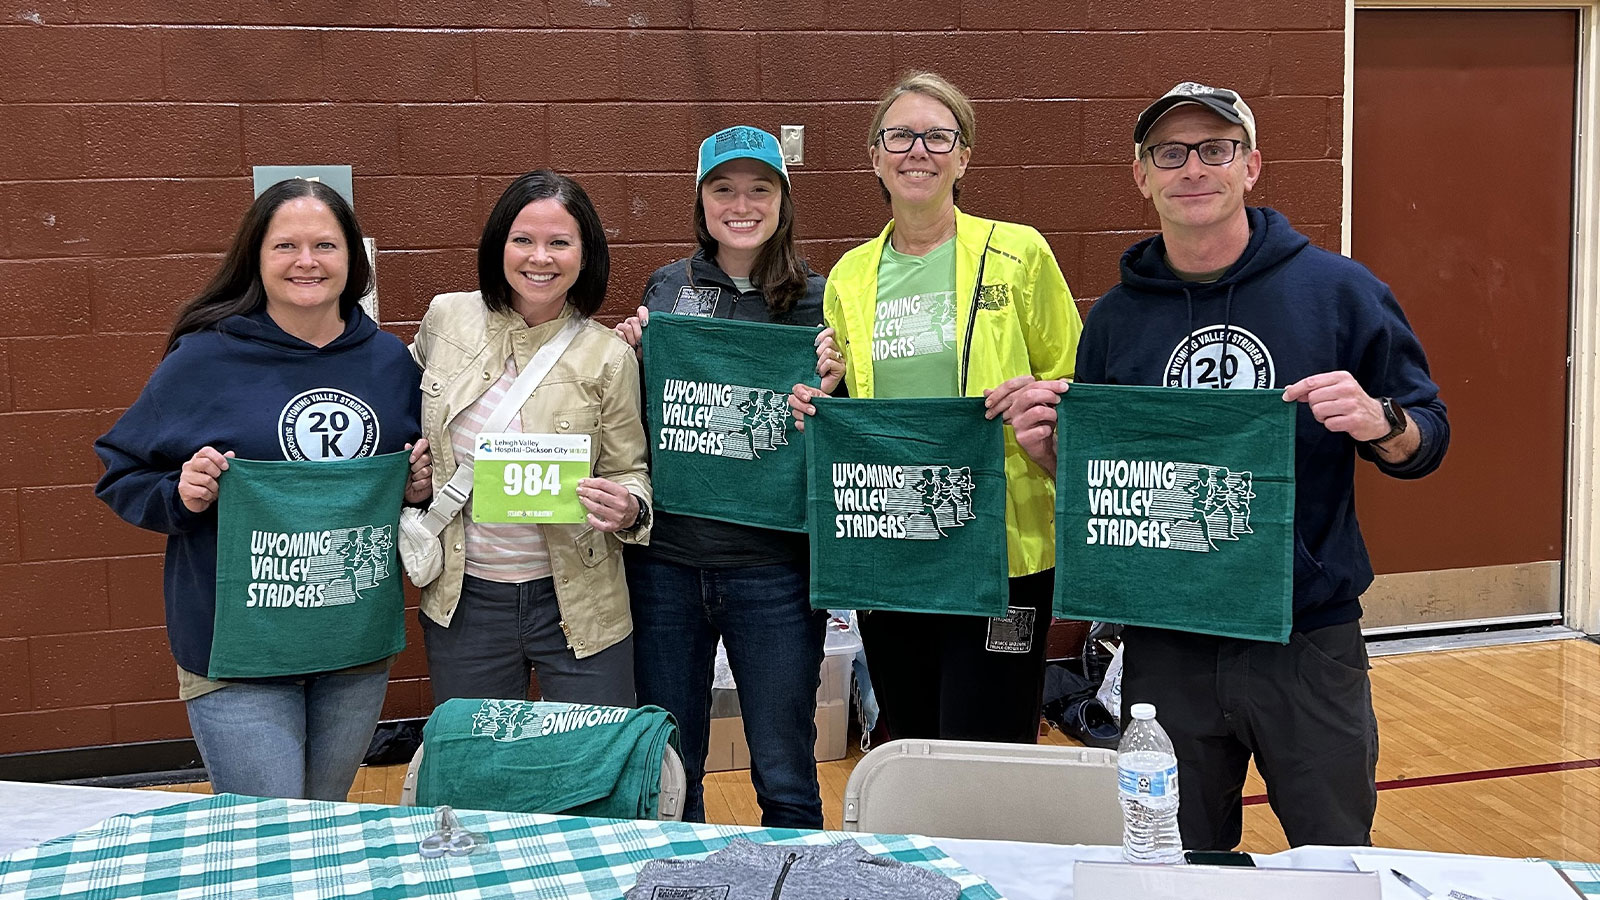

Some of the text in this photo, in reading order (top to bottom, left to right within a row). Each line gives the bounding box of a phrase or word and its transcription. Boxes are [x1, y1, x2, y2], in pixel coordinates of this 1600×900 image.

[874, 295, 921, 320] OMING
[873, 317, 904, 338] LLEY
[872, 336, 916, 361] RIDERS
[1231, 333, 1265, 366] STRIDERS
[1195, 354, 1239, 384] 20
[663, 379, 732, 408] WYOMING
[285, 393, 371, 424] WYOMING VALLEY STRIDERS
[662, 403, 714, 428] VALLEY
[308, 410, 350, 433] 20
[321, 433, 344, 458] K
[519, 440, 540, 448] Valley
[553, 446, 568, 455] City
[658, 428, 725, 456] STRIDERS
[503, 463, 562, 496] 984
[832, 463, 905, 488] WYOMING
[1087, 459, 1177, 490] WYOMING
[834, 488, 888, 512] VALLEY
[1088, 488, 1154, 517] VALLEY
[835, 514, 907, 539] STRIDERS
[1086, 517, 1171, 549] STRIDERS
[251, 530, 332, 557] WYOMING
[251, 556, 311, 581] VALLEY
[246, 583, 325, 608] STRIDERS
[541, 708, 629, 736] WYOMING
